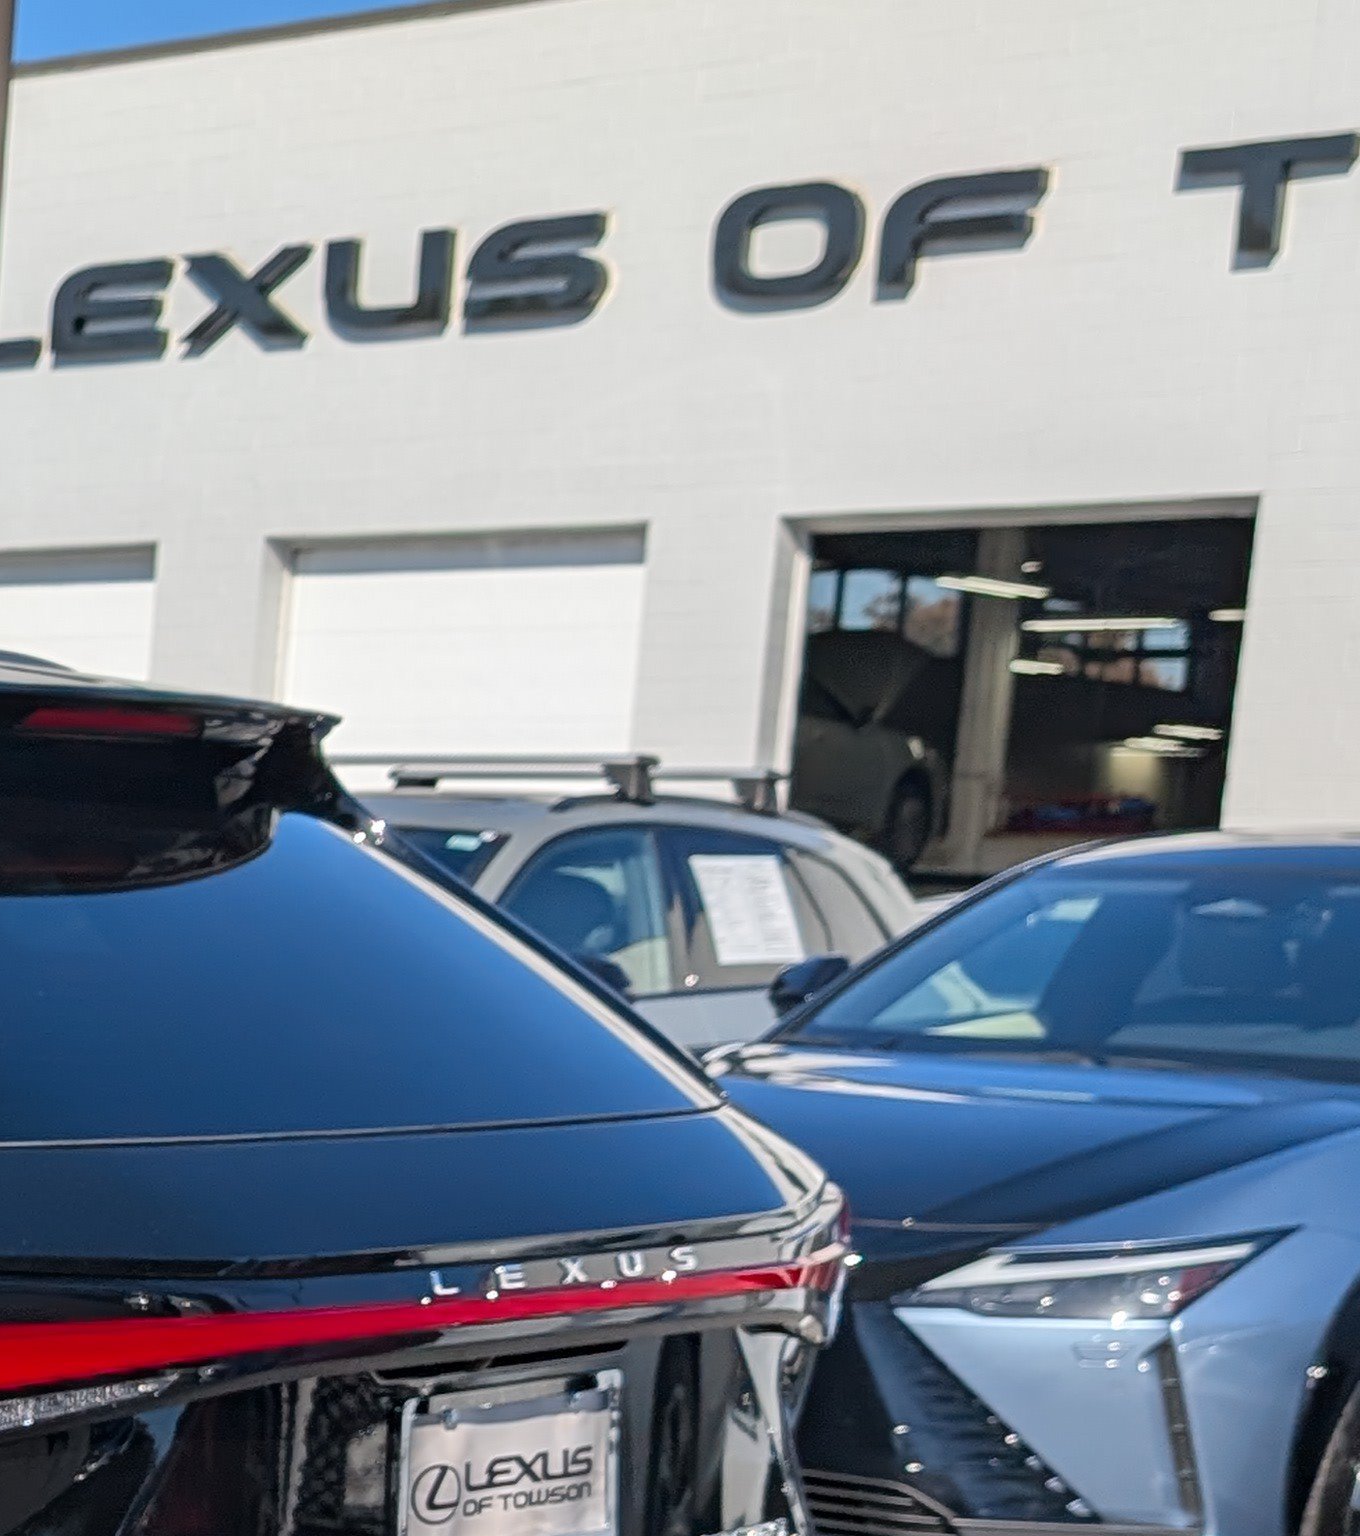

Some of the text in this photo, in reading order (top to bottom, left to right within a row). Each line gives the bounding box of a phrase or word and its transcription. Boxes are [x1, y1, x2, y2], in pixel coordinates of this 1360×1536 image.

[712, 167, 1050, 313] OF
[1177, 131, 1359, 270] T
[430, 1246, 699, 1297] LEXUS
[464, 1445, 593, 1492] LEXUS
[462, 1495, 495, 1518] OF
